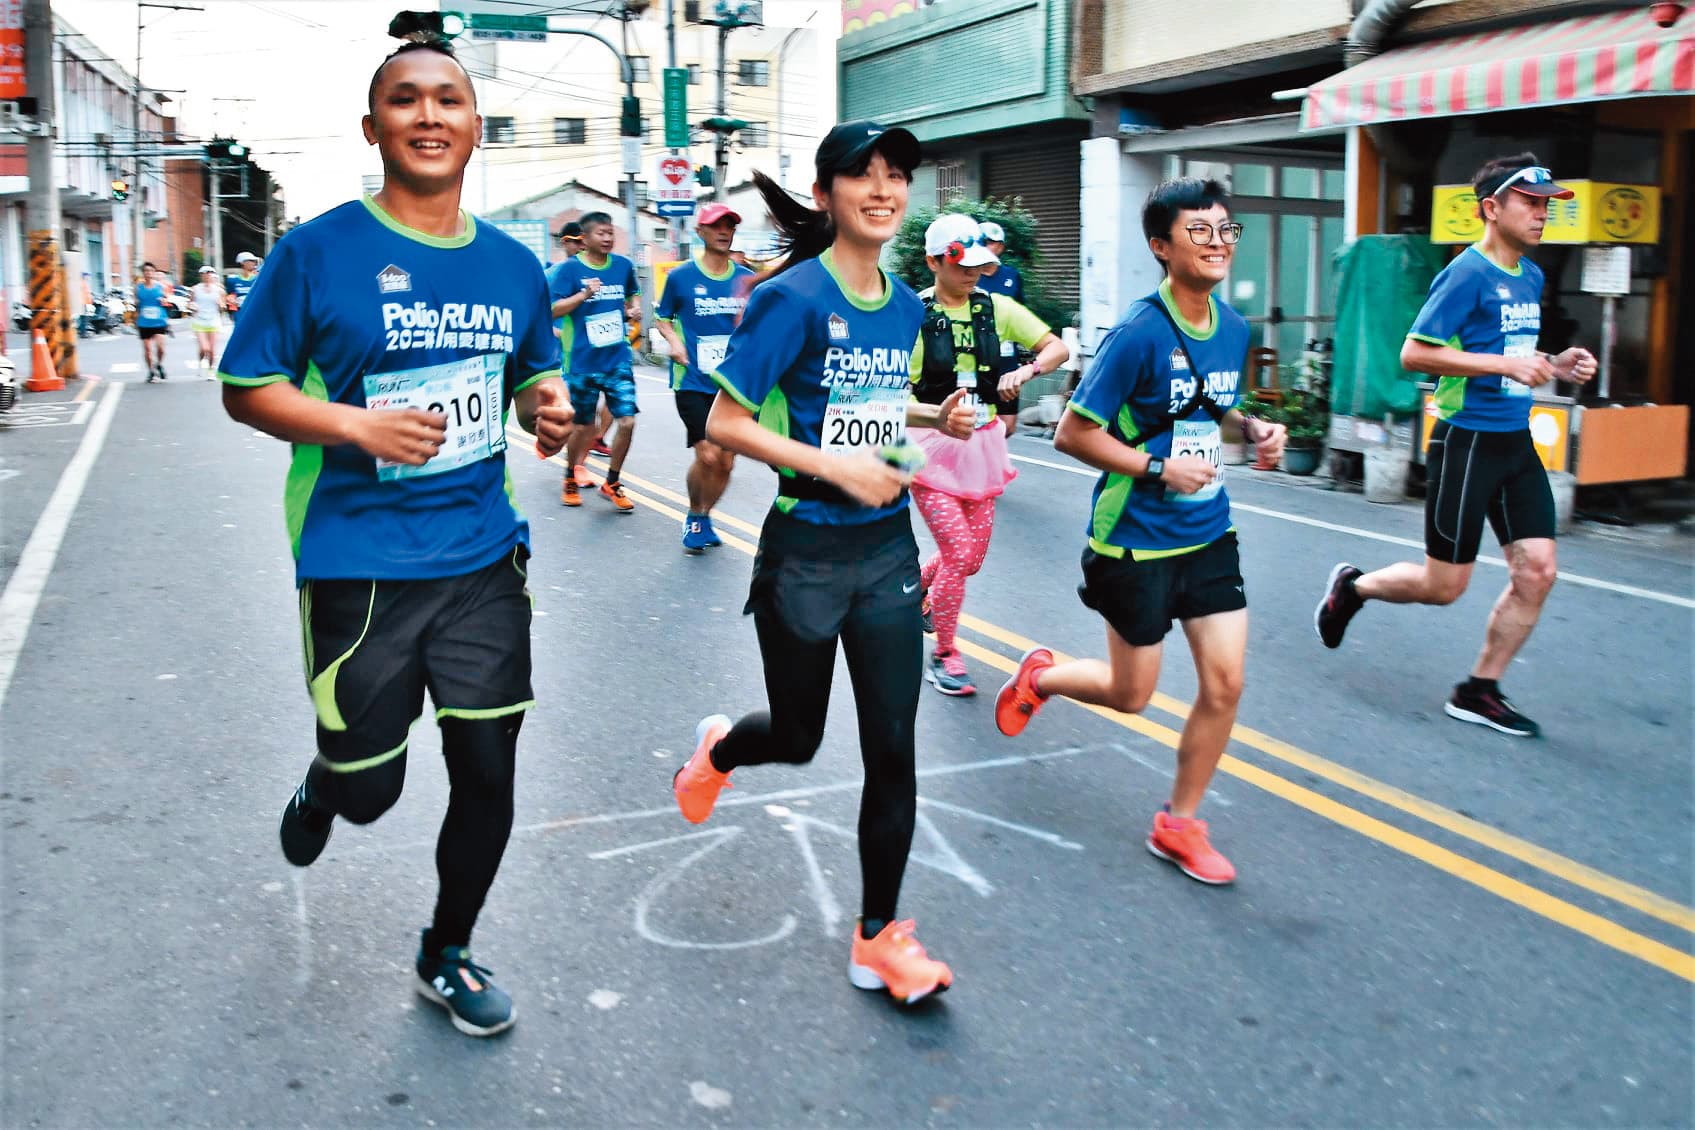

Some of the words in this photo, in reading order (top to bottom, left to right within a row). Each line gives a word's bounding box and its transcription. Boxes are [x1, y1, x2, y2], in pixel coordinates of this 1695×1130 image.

[382, 302, 439, 330] Polio
[824, 347, 871, 372] Polio
[830, 418, 900, 447] 20081
